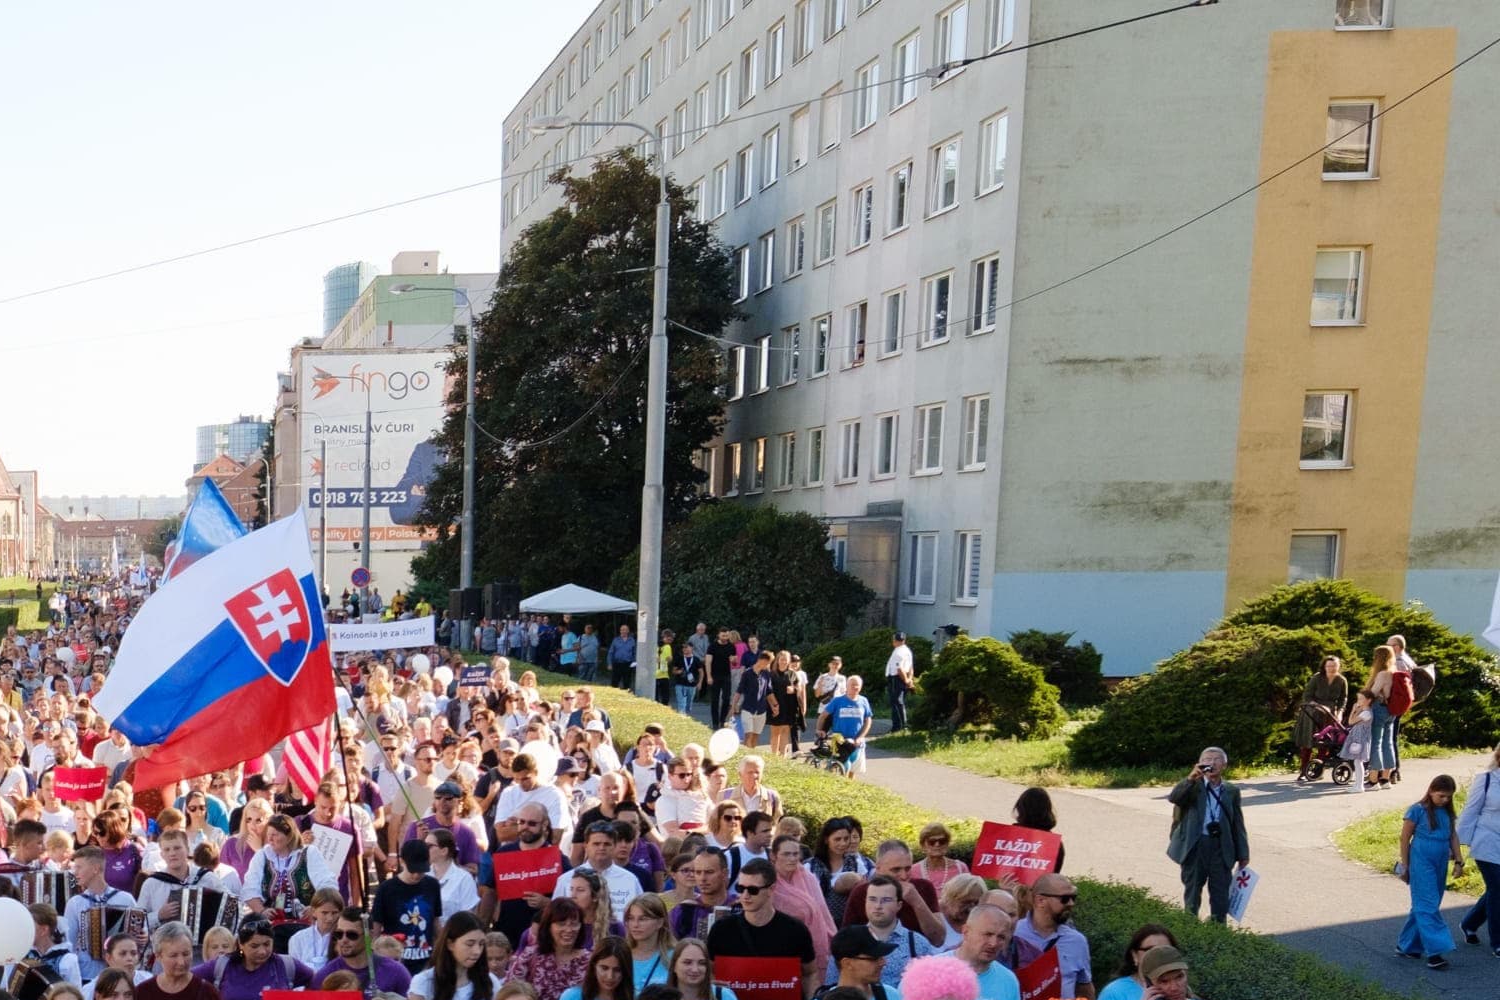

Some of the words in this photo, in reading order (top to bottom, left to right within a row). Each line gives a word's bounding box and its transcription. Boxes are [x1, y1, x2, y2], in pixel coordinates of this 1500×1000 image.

[351, 363, 430, 400] fingo
[386, 421, 414, 433] ČURI
[380, 491, 408, 504] 223
[311, 529, 346, 541] Rality
[993, 838, 1043, 854] KAŽDÝ
[977, 853, 994, 866] JE
[996, 853, 1051, 870] VZÁCNY
[747, 981, 757, 991] je
[771, 980, 795, 989] život
